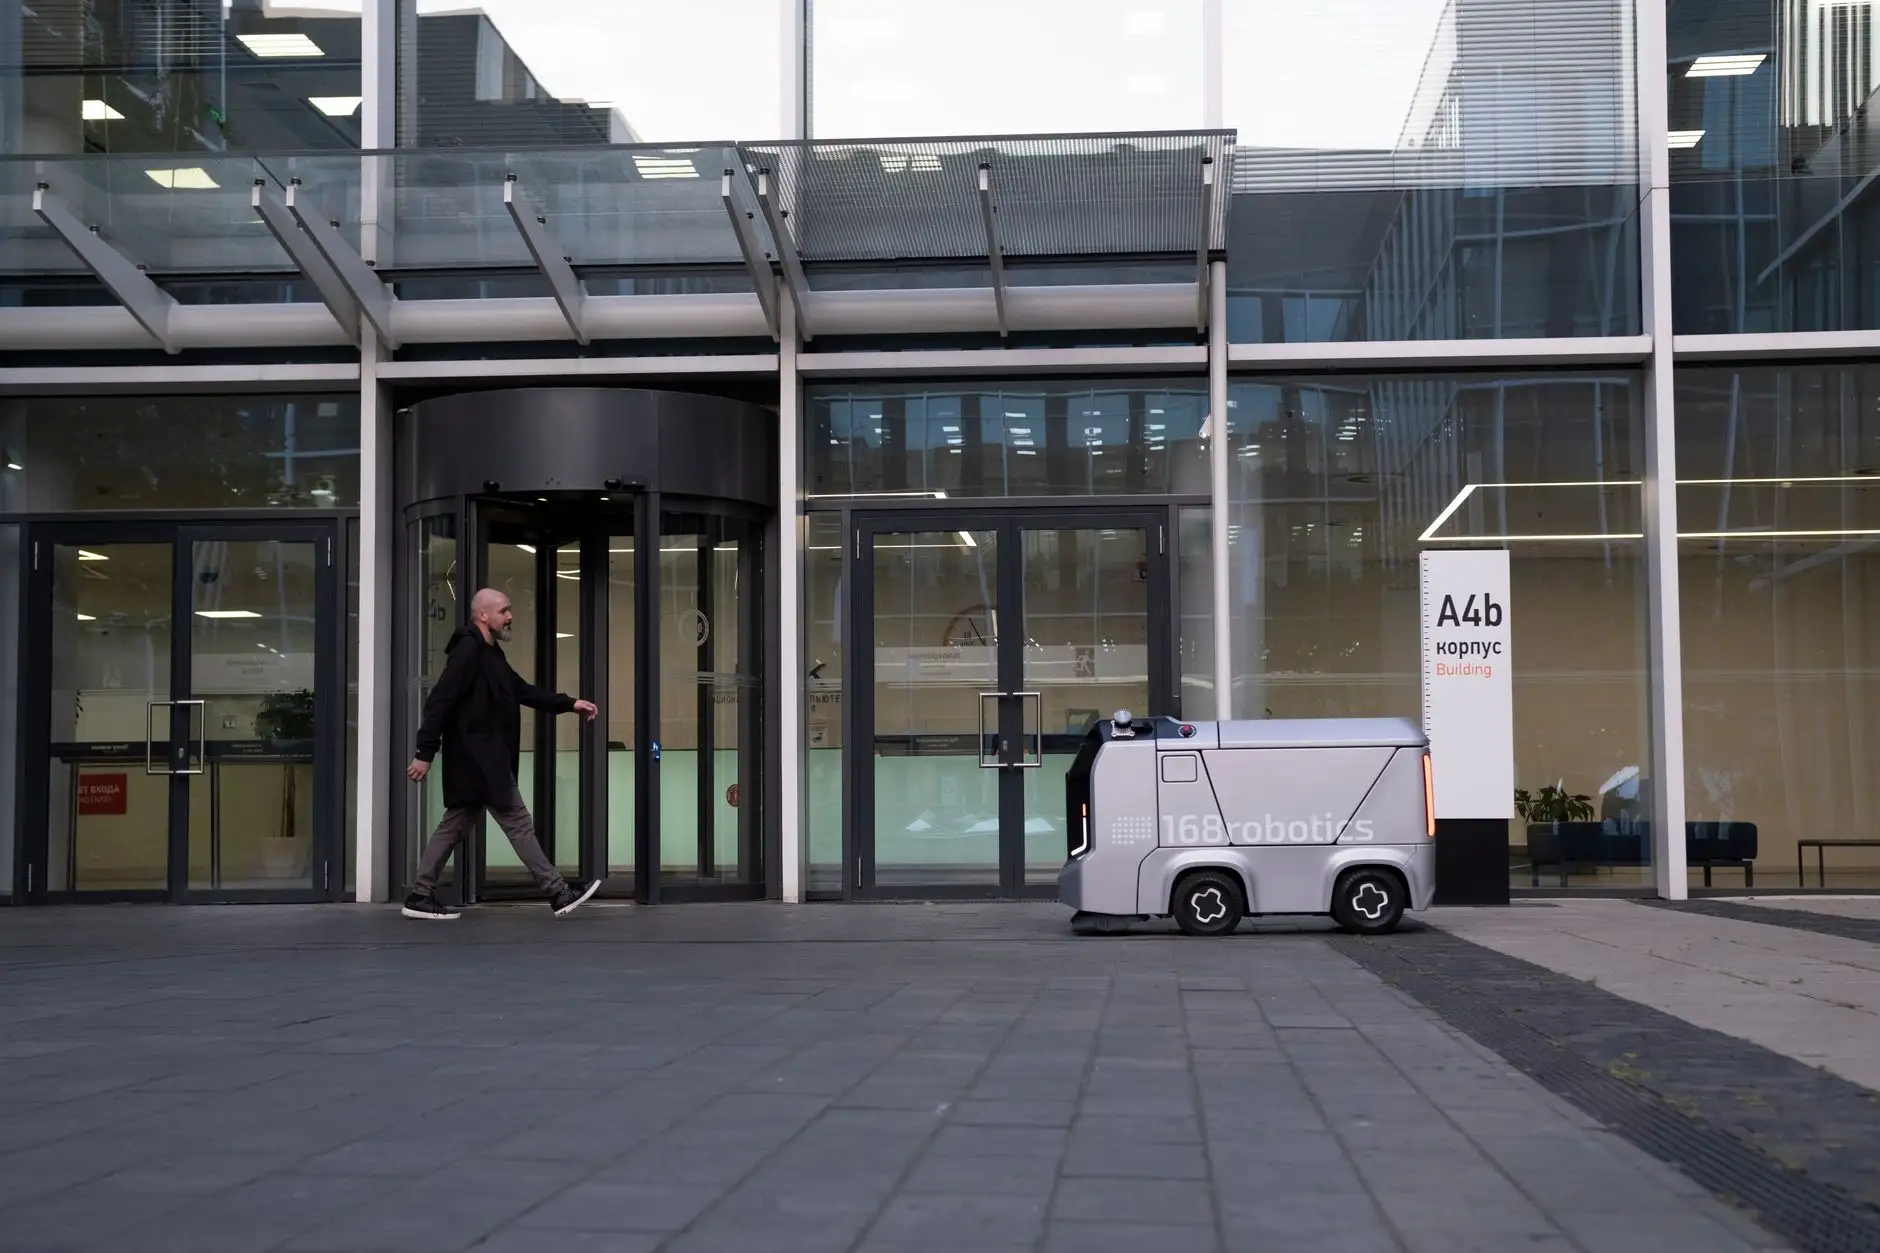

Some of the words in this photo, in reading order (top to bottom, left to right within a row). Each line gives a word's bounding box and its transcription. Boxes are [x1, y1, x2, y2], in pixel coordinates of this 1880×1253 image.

[1436, 593, 1503, 627] A4b
[1436, 641, 1502, 659] корпус
[1436, 662, 1493, 678] Building
[90, 785, 120, 794] ВХОДА
[1162, 812, 1374, 844] 168robotics
